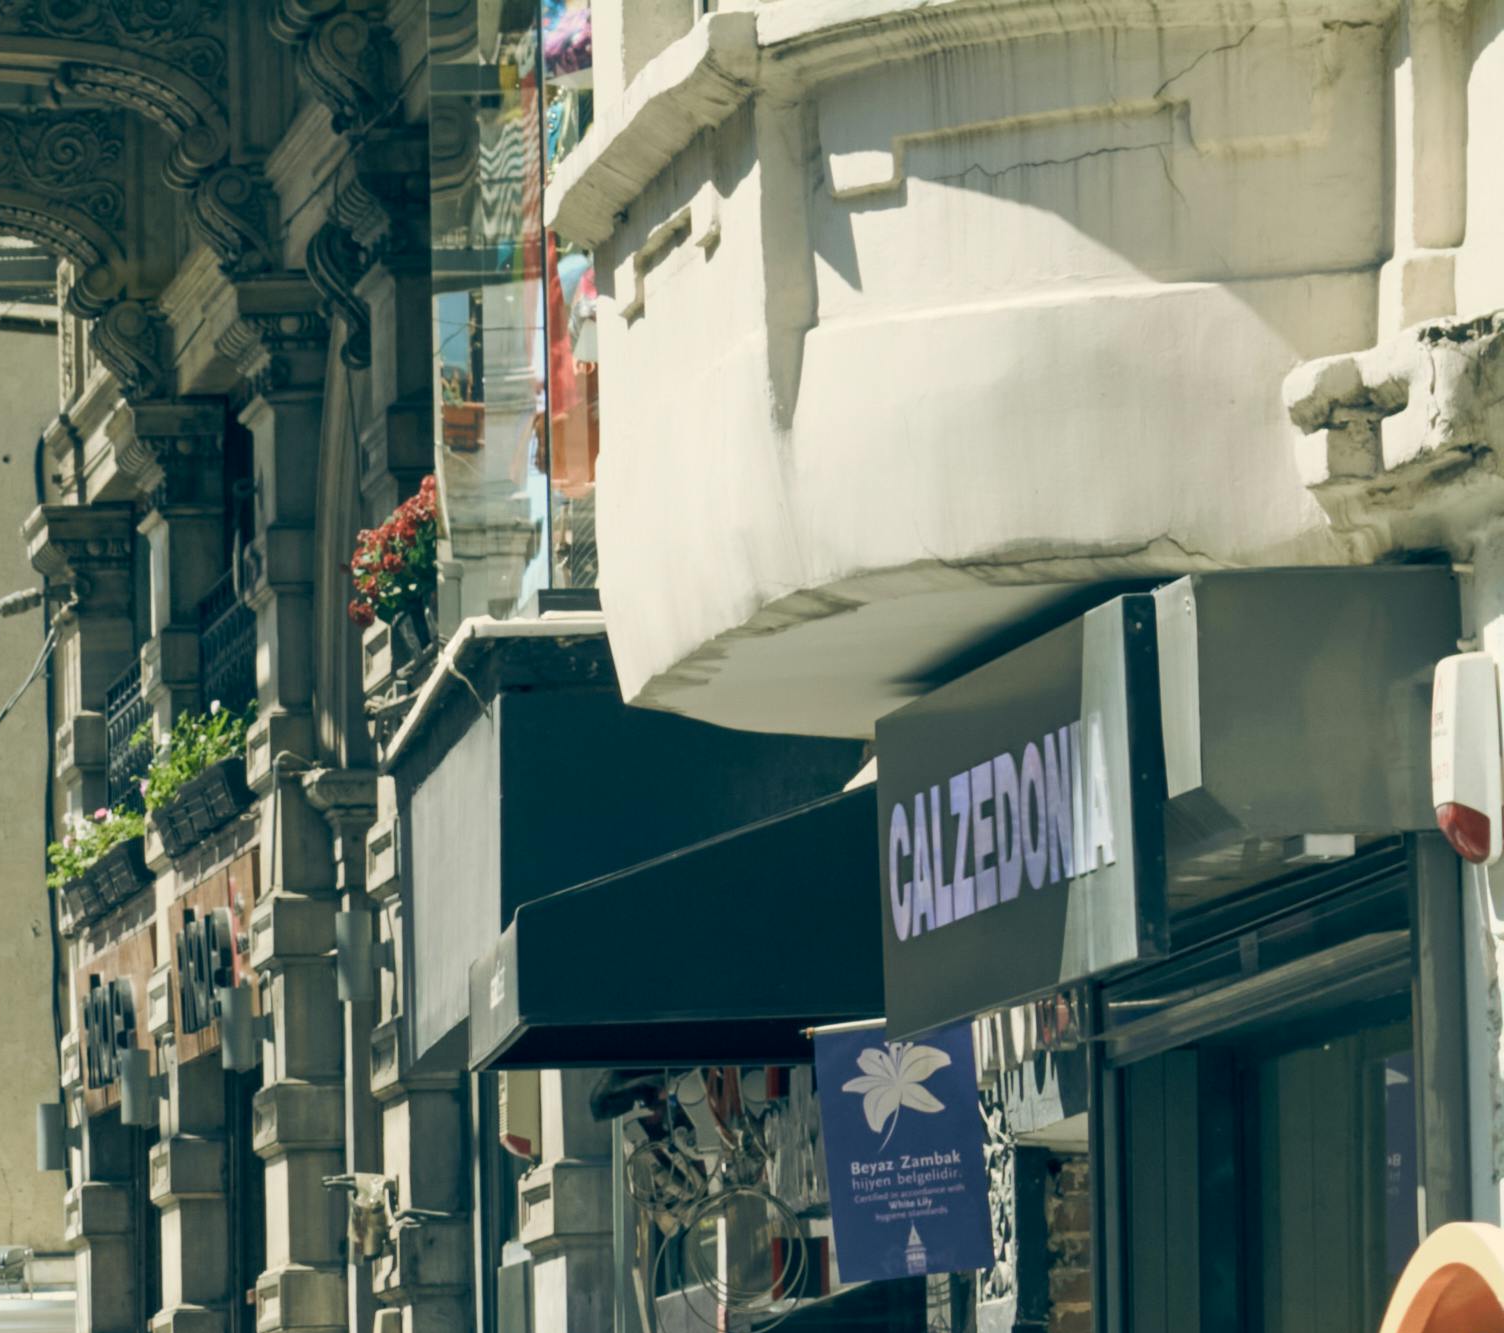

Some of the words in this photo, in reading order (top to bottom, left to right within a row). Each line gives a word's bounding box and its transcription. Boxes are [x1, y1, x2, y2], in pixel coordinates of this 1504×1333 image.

[889, 711, 1115, 942] CALZEDONIA
[850, 1160, 895, 1177] Beyaz
[900, 1149, 961, 1169] Zambak
[851, 1178, 892, 1192] hijyen
[897, 1169, 962, 1187] belgelidir.
[888, 1199, 915, 1210] White
